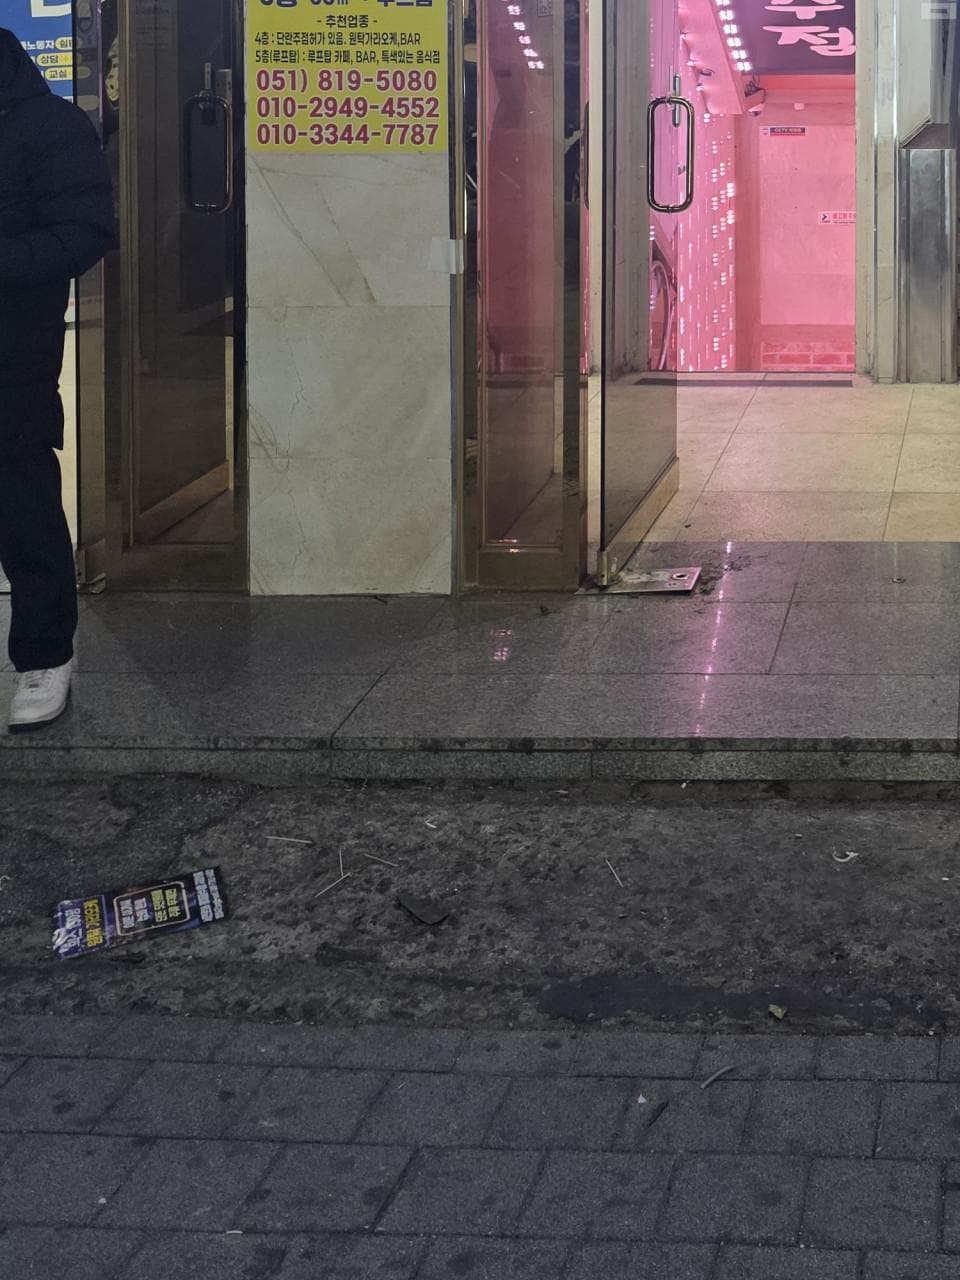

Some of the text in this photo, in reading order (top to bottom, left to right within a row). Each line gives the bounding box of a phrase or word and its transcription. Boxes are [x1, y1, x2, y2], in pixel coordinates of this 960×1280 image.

[325, 14, 370, 29] 추천업종
[255, 32, 270, 45] 4층
[276, 31, 326, 46] 단란주점허가
[307, 50, 332, 65] 루프탑
[416, 50, 440, 65] 음식점
[256, 68, 438, 94] 051) 819-5080
[256, 96, 440, 119] 010-2949-4552
[256, 123, 440, 146] 010-3344-7787
